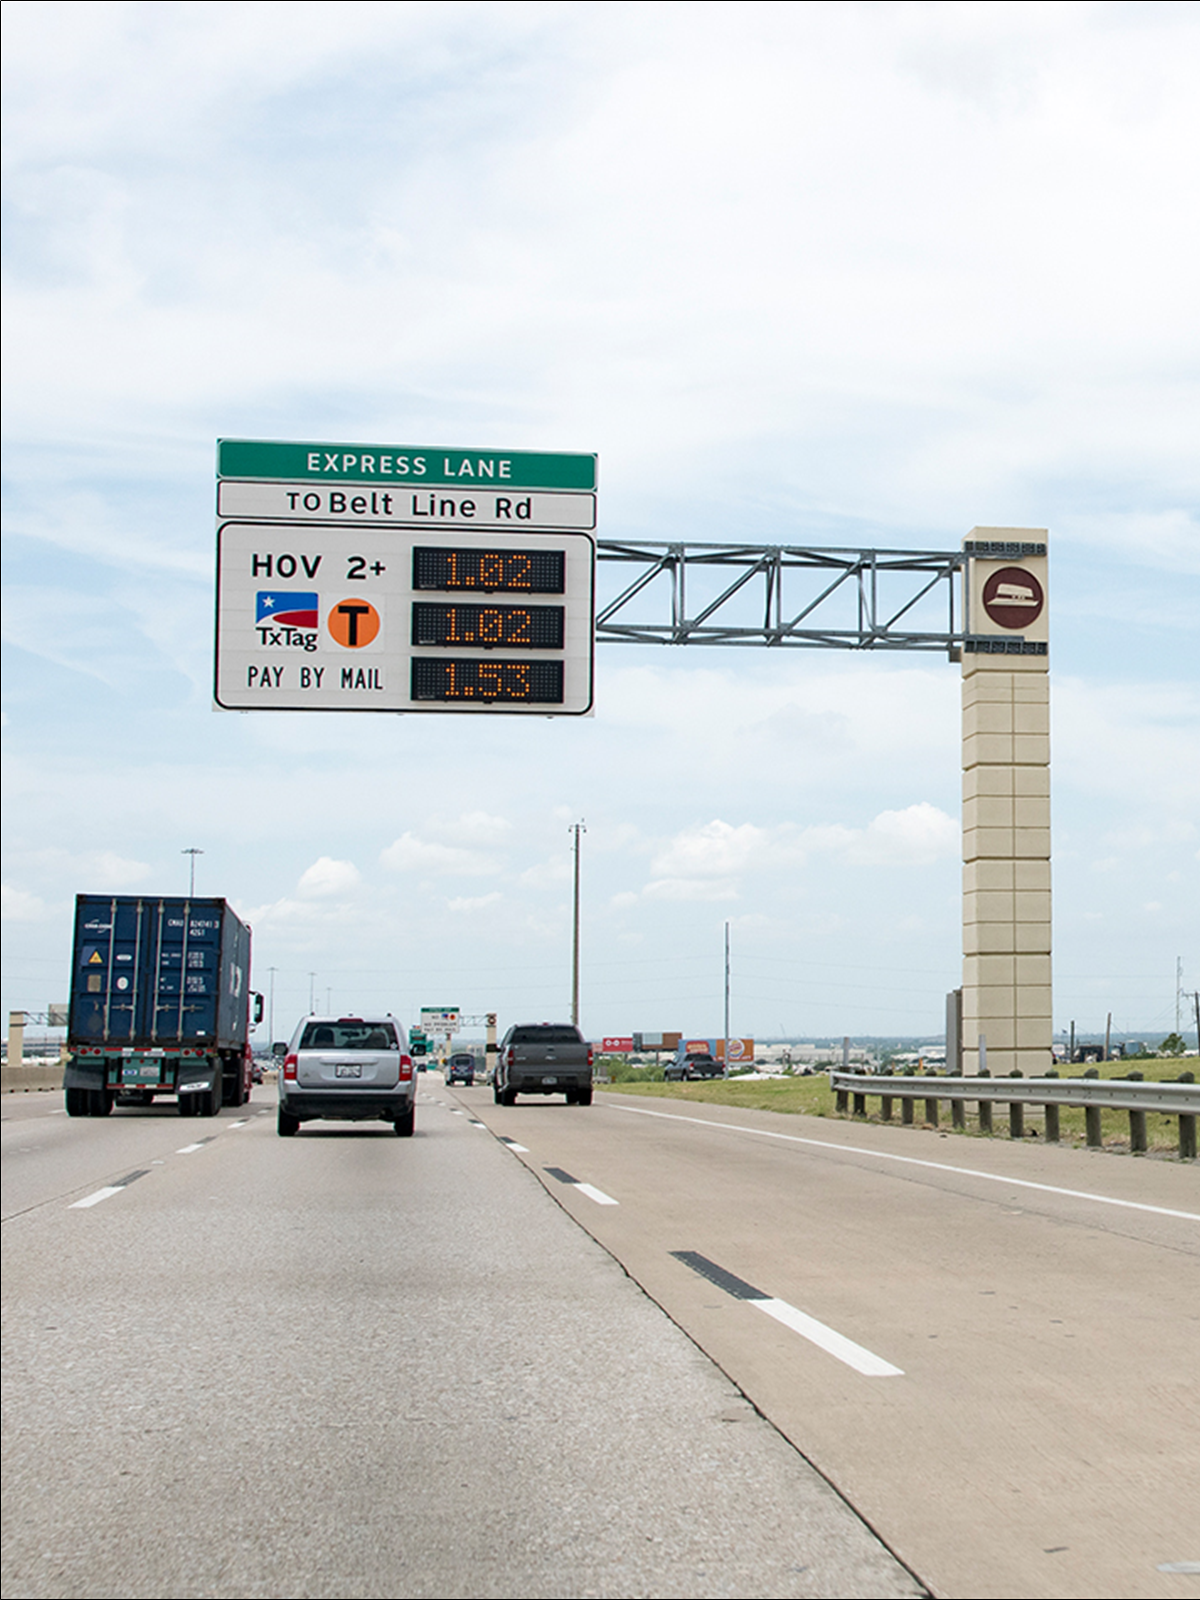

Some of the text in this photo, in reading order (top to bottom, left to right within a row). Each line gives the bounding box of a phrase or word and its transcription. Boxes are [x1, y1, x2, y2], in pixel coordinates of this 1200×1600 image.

[307, 453, 512, 479] EXPRESS LANE
[286, 492, 532, 519] TO Belt Line Rd
[252, 553, 386, 580] HOV 2+
[446, 552, 531, 587] 1.02
[338, 605, 369, 646] T
[445, 608, 531, 643] 1.02
[255, 627, 318, 652] TxTag
[248, 665, 384, 690] PAY BY MAIL
[445, 663, 531, 697] 1.53
